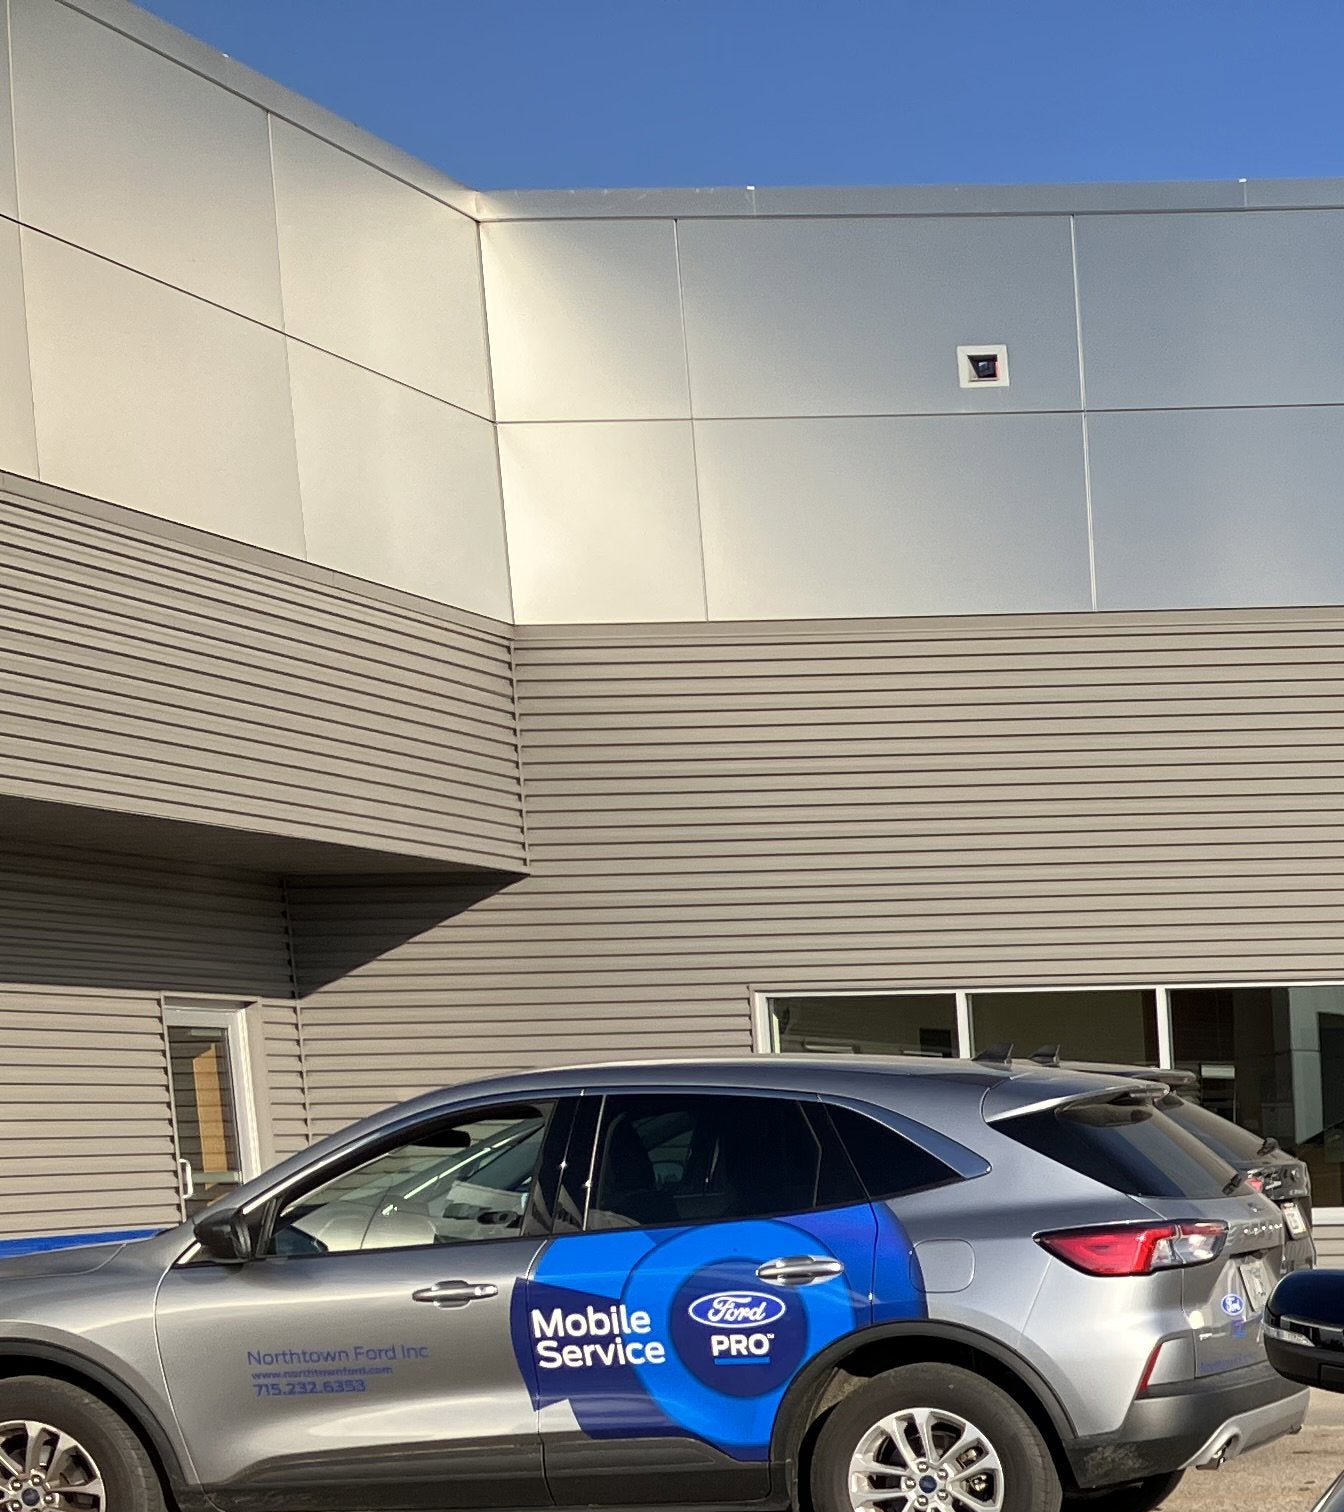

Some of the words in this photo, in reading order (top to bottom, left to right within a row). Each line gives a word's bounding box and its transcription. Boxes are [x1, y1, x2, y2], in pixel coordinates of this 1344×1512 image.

[531, 1304, 651, 1338] Mobile
[707, 1296, 767, 1322] Ford
[247, 1349, 349, 1366] Northtown
[353, 1344, 397, 1361] Ford
[401, 1344, 429, 1360] Inc
[537, 1336, 666, 1369] Service
